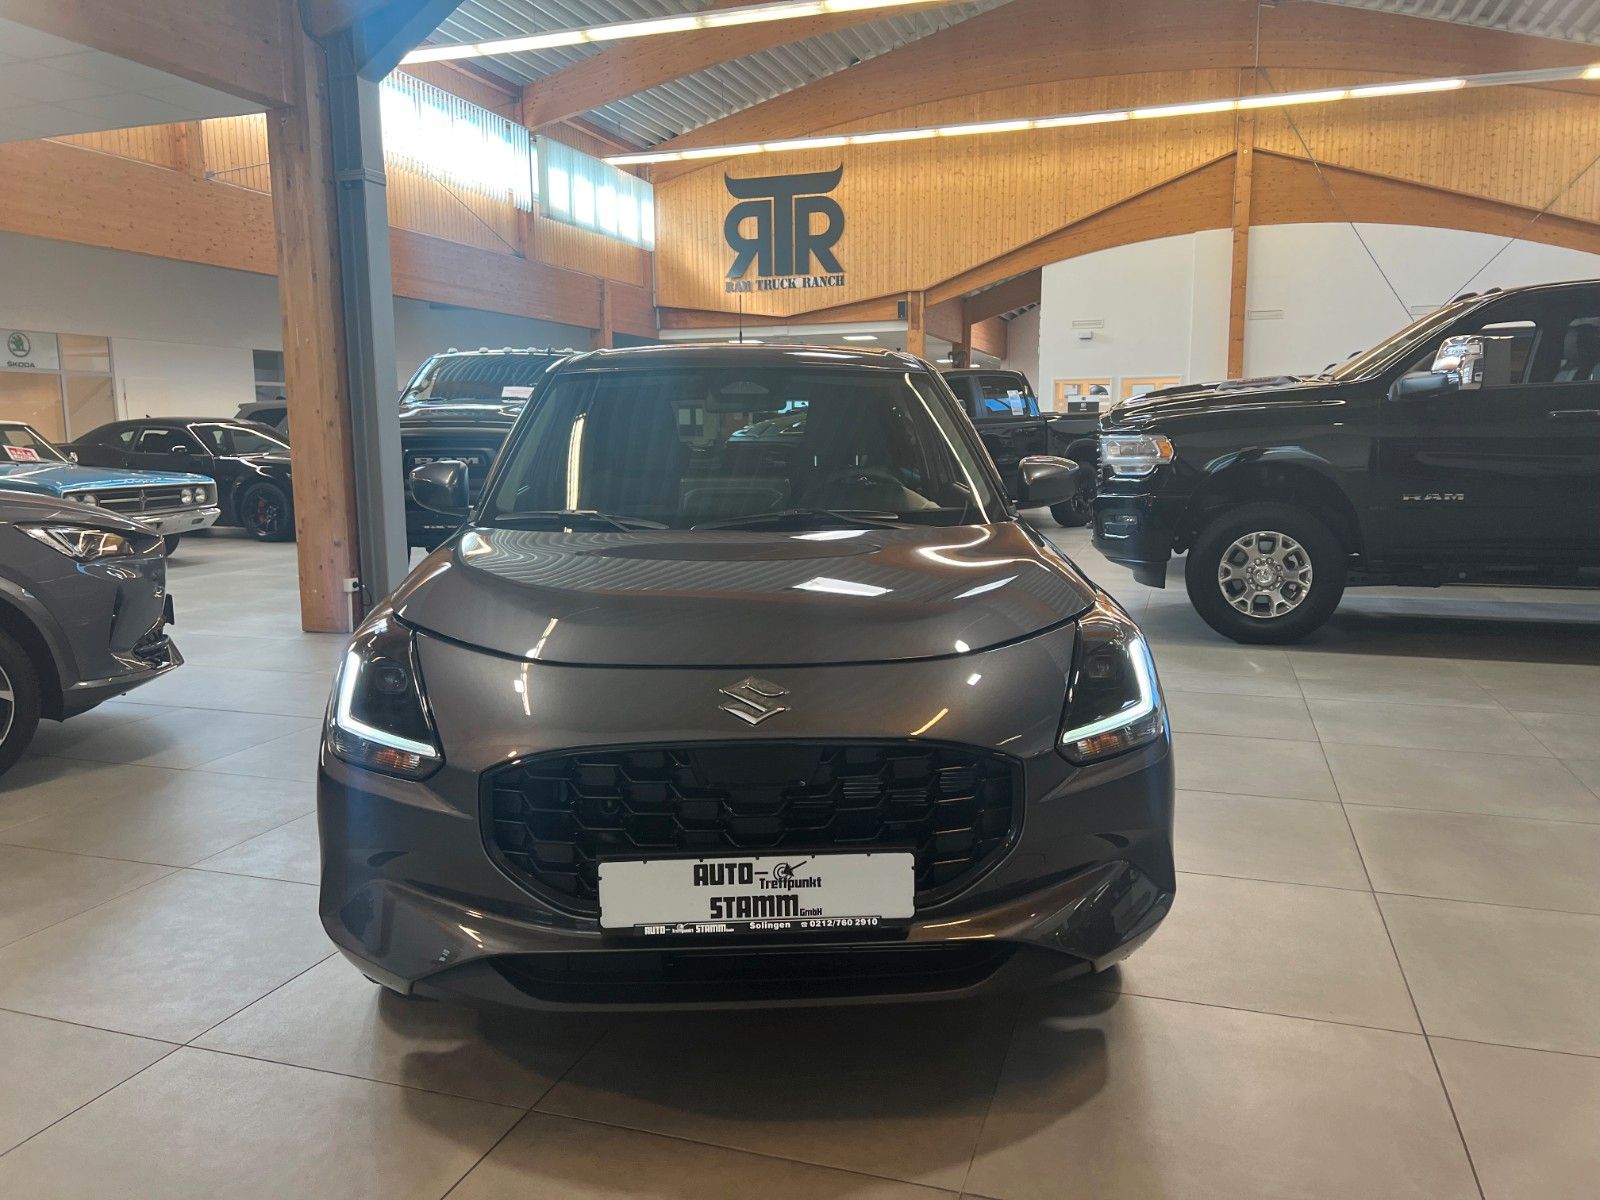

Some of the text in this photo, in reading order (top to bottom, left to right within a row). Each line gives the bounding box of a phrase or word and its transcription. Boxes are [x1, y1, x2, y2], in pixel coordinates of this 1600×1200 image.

[725, 275, 845, 293] RAM TRUCK RANCH
[1402, 493, 1465, 501] RAM
[759, 877, 822, 891] Treffpunkt
[710, 894, 823, 919] STAMM GmbH
[749, 918, 878, 930] Solingen 0212/760 2910
